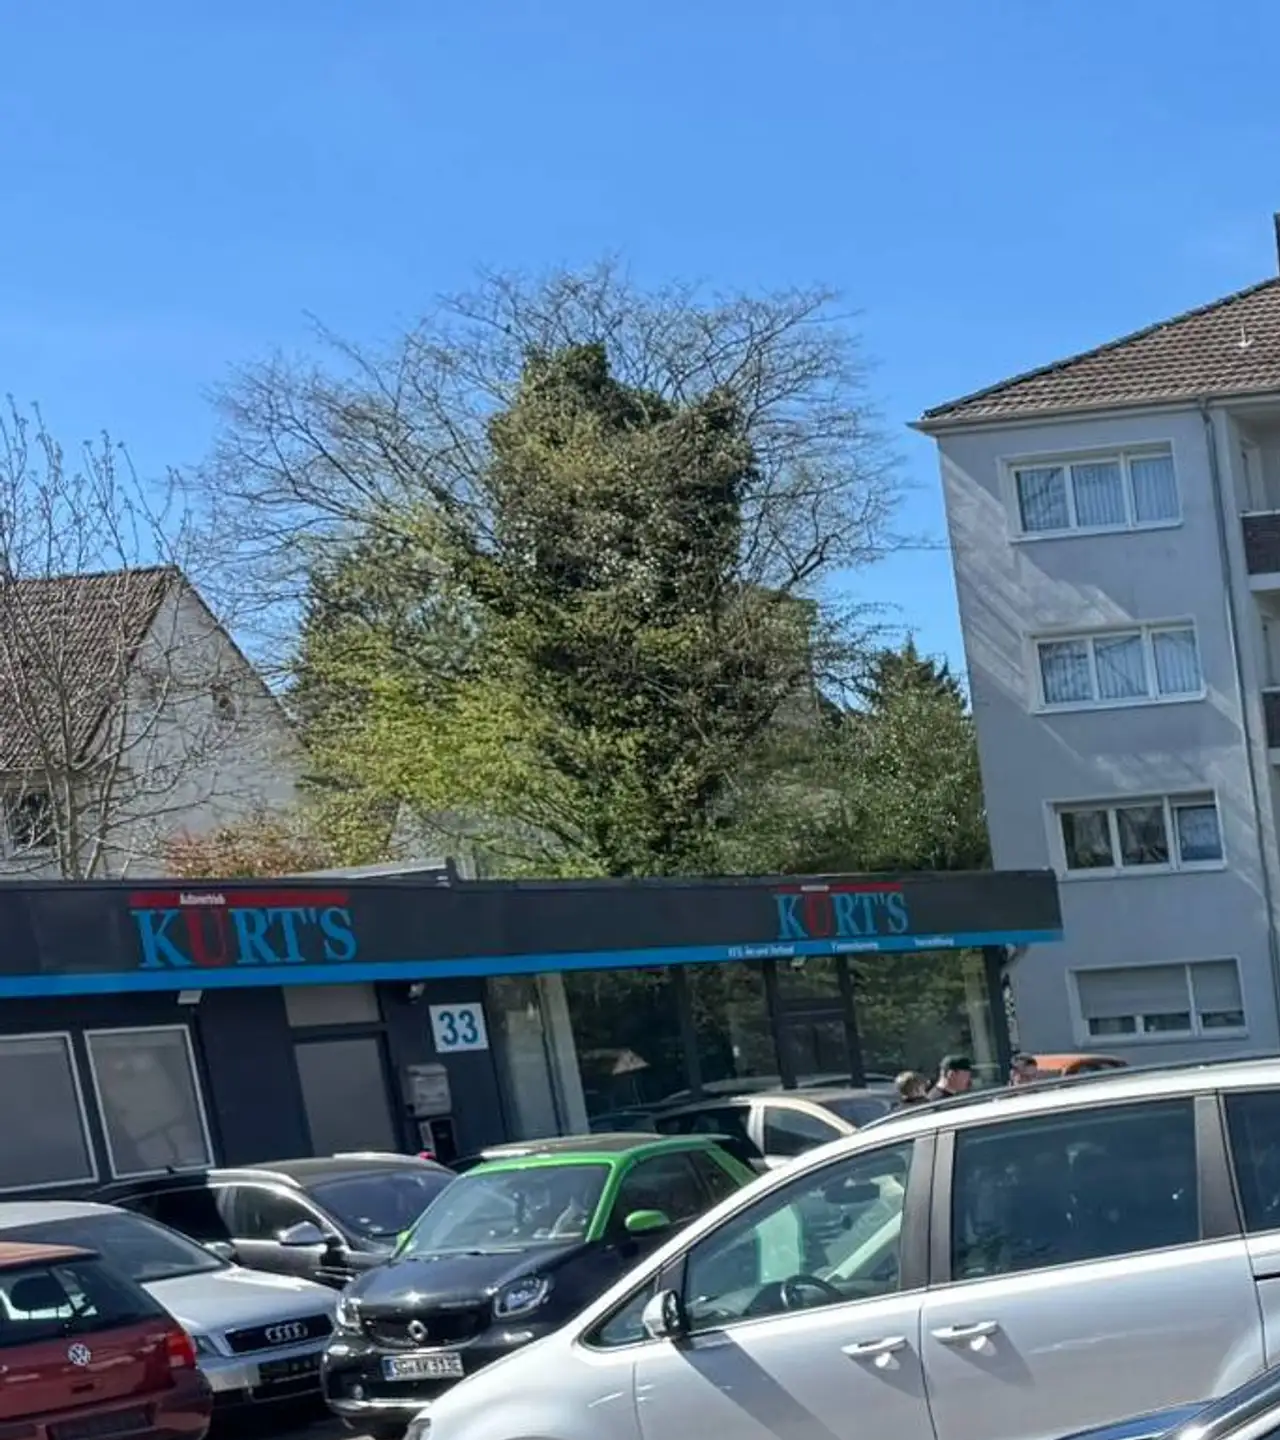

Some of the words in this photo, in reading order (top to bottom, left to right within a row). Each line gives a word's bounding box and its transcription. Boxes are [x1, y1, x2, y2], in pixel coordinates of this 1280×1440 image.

[131, 906, 358, 968] KURT'S
[773, 891, 909, 939] KURT'S
[438, 1009, 479, 1047] 33
